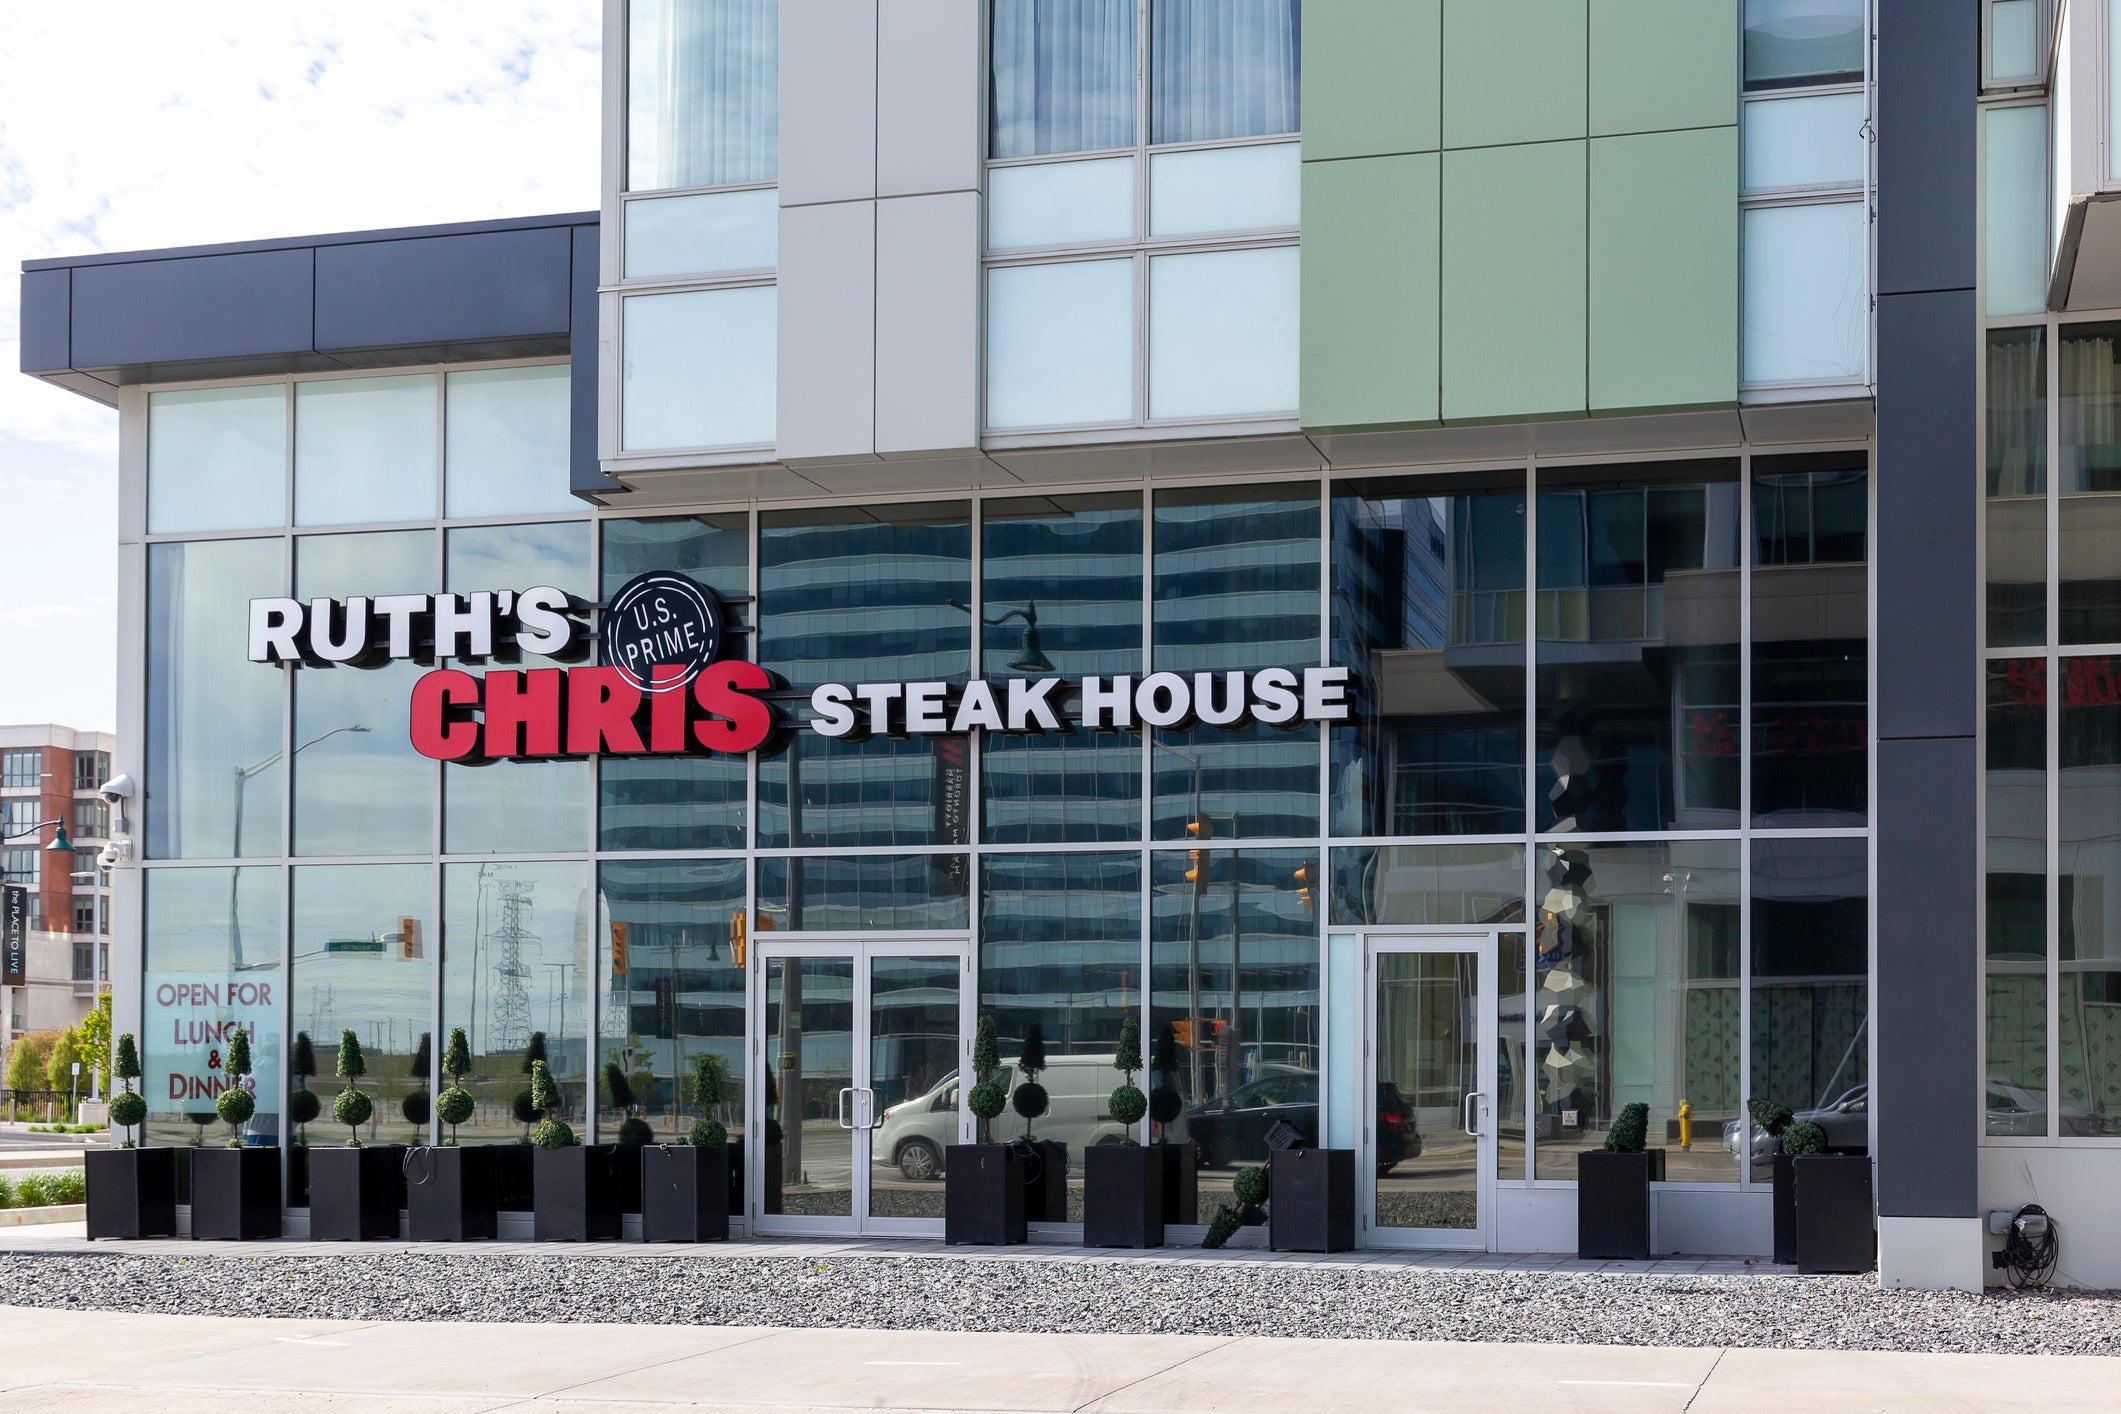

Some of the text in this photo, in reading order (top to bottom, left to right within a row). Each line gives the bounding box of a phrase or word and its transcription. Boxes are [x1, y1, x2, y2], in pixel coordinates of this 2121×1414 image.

[247, 585, 572, 662] RUTH'S
[633, 597, 677, 631] U.S.
[625, 621, 699, 670] PRIME
[410, 660, 771, 760] CHRIS
[810, 667, 1349, 737] STEAK HOUSE
[10, 890, 20, 974] the PLACE TO LIVE
[156, 982, 272, 1007] OPEN FOR
[174, 1018, 255, 1044] LUNCH
[207, 1049, 222, 1070] &
[169, 1073, 257, 1100] DINNR
